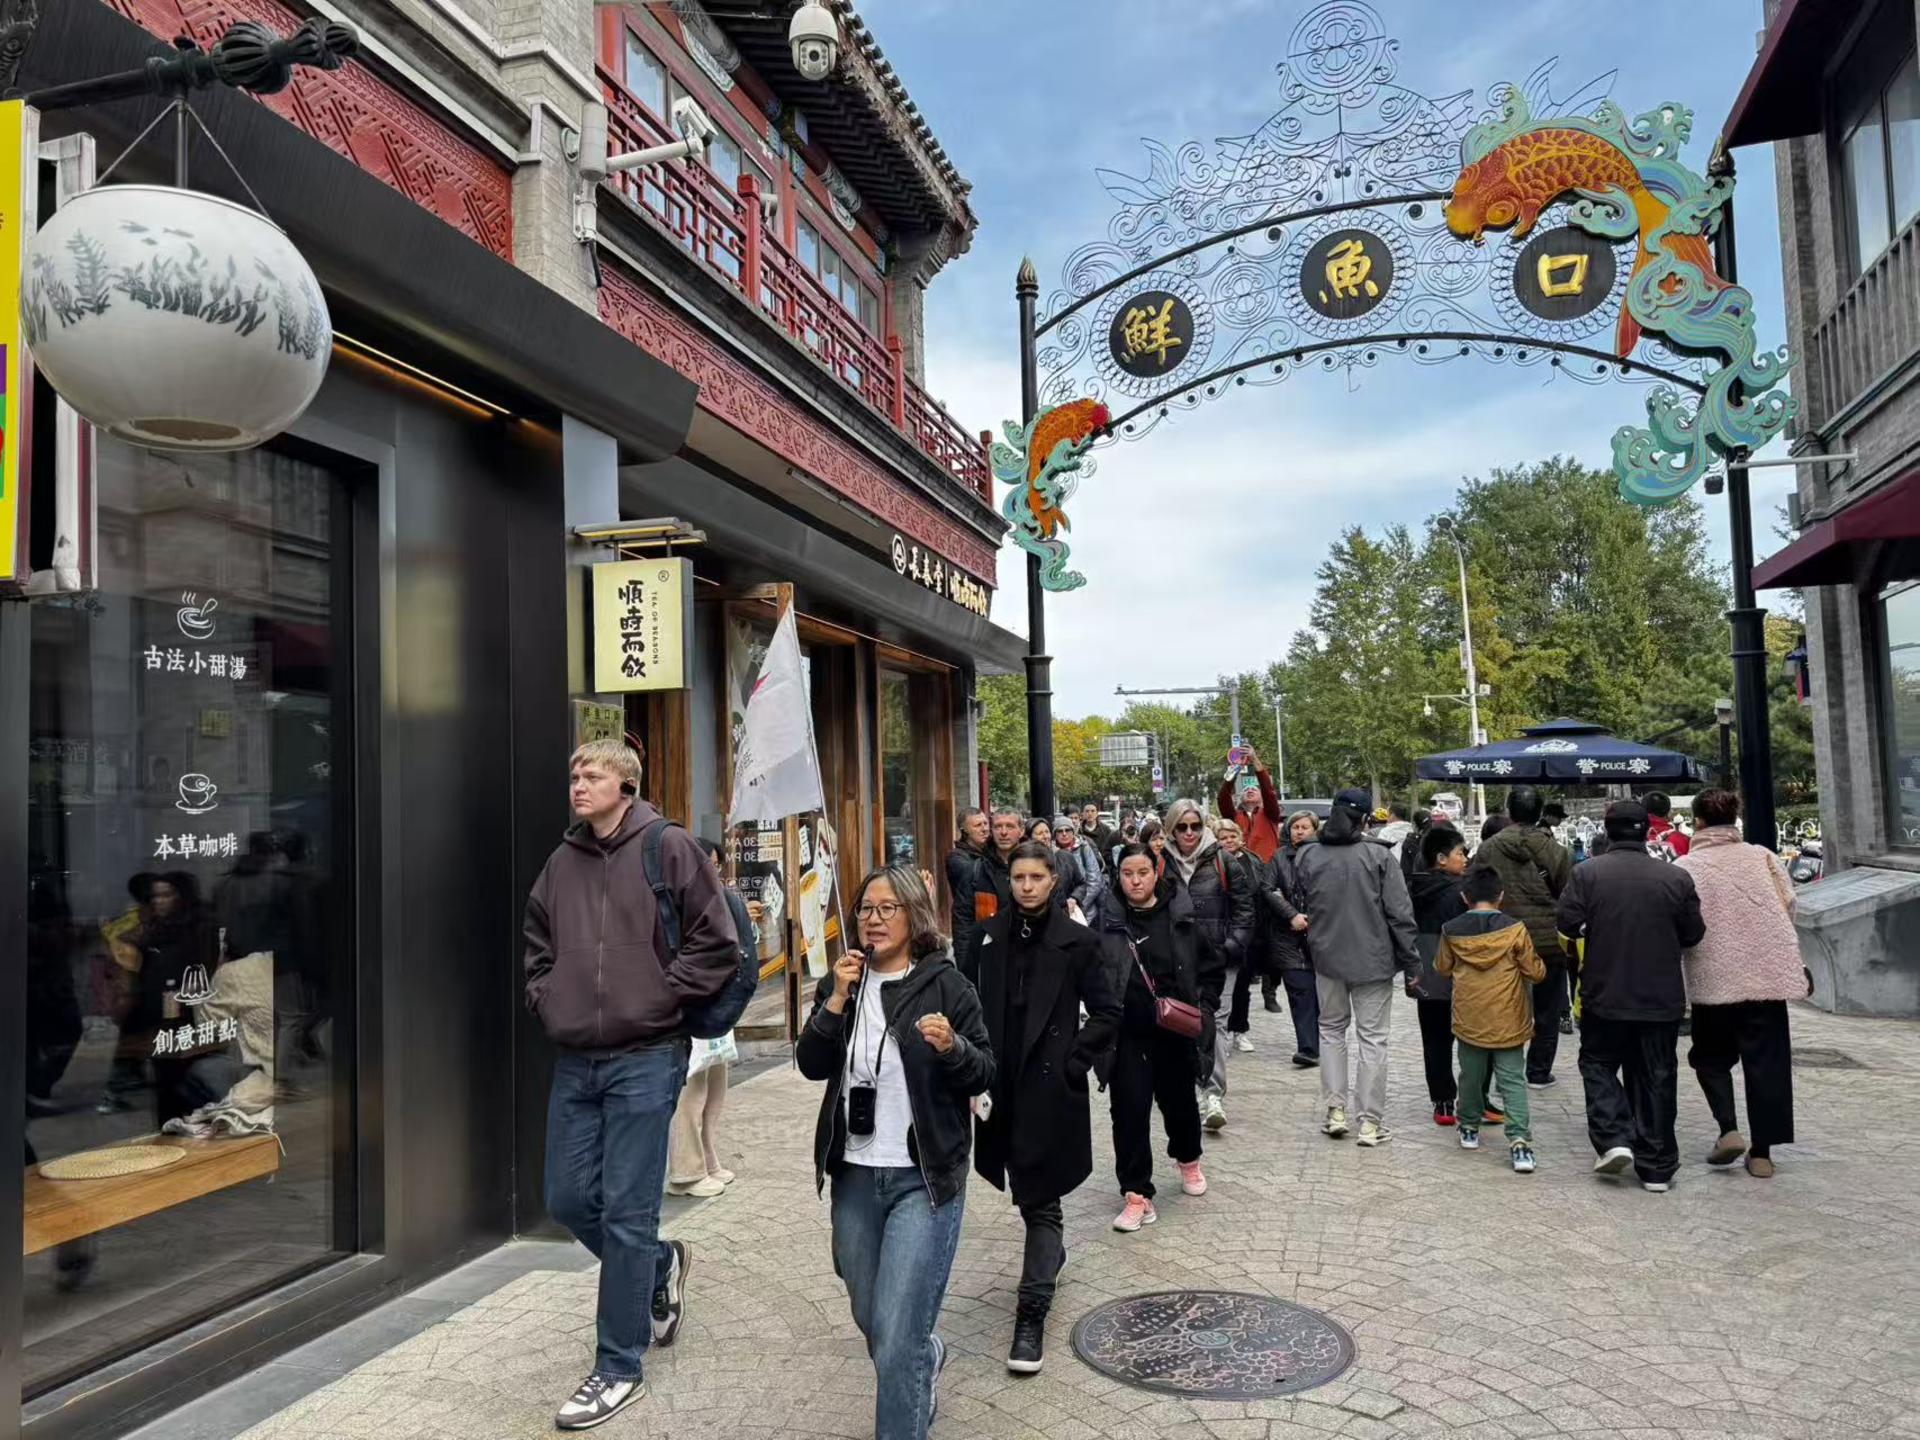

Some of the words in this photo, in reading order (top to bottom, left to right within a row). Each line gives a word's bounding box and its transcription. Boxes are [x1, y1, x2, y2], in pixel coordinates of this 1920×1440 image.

[652, 625, 660, 665] SEASONS
[143, 644, 248, 680] 古法小甜湯
[1444, 758, 1467, 775] 警
[1467, 762, 1492, 772] POLICE
[1493, 758, 1514, 775] 察
[1576, 758, 1599, 775] 警
[1600, 762, 1626, 770] POLICE
[1627, 758, 1652, 775] 察
[153, 832, 239, 861] 本草咖啡
[151, 1016, 238, 1057] 創意甜點
